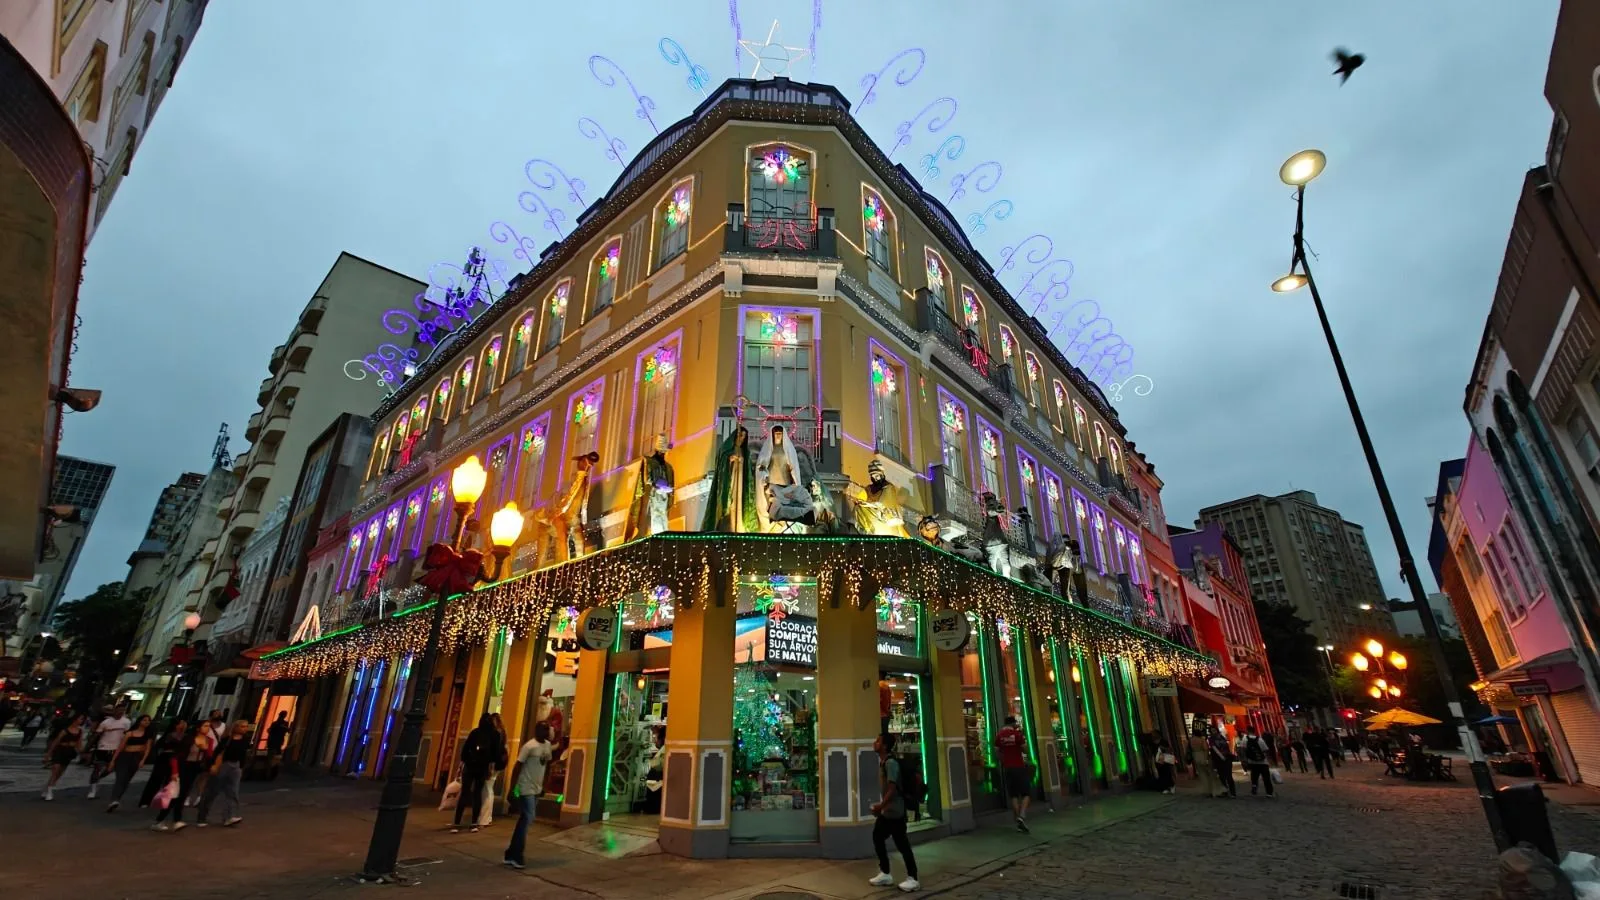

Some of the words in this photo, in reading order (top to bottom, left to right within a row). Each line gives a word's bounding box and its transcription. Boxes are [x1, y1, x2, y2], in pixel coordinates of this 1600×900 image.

[769, 629, 818, 645] COMPLETA
[769, 639, 787, 650] SUA
[769, 649, 781, 659] DE
[782, 651, 812, 663] NATAL
